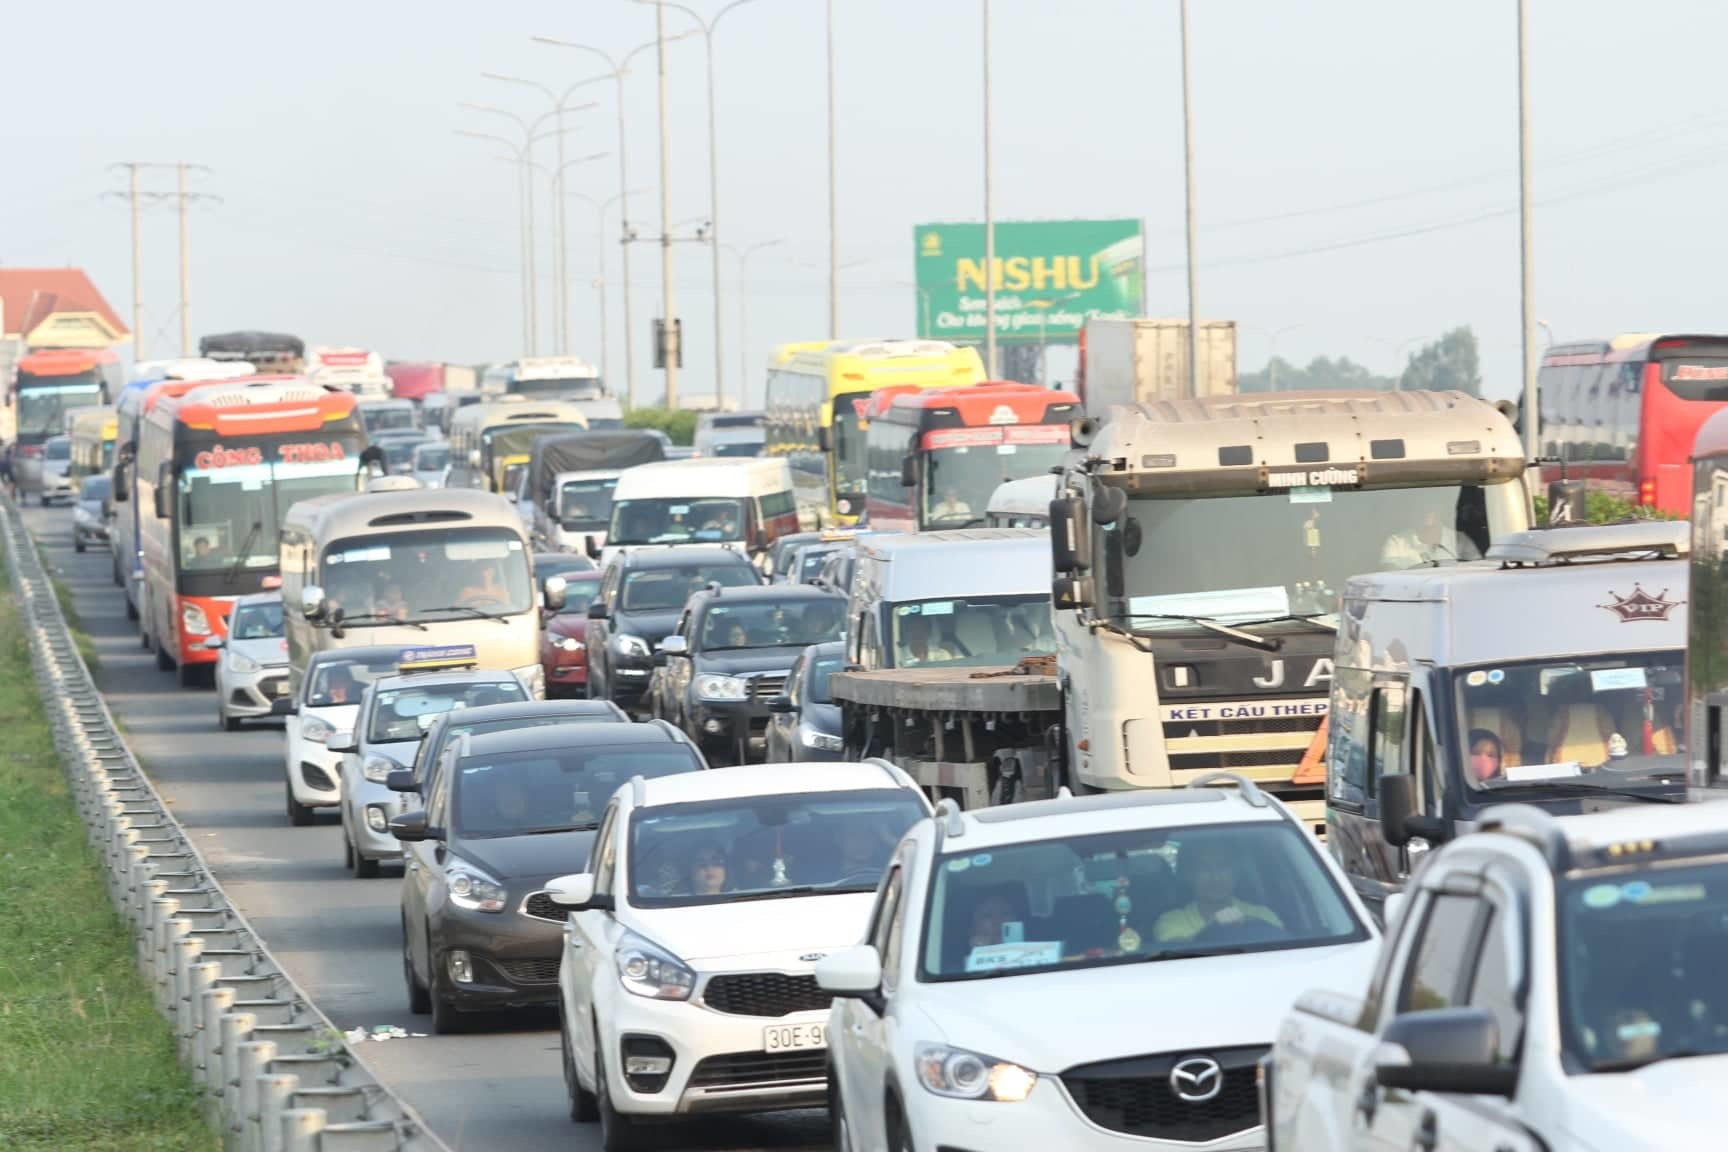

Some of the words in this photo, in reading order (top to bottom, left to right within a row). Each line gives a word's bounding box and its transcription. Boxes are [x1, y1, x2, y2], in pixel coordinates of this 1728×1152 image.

[956, 255, 1100, 292] NISHU
[1622, 603, 1665, 612] VIP
[768, 1026, 828, 1049] 30E-9
